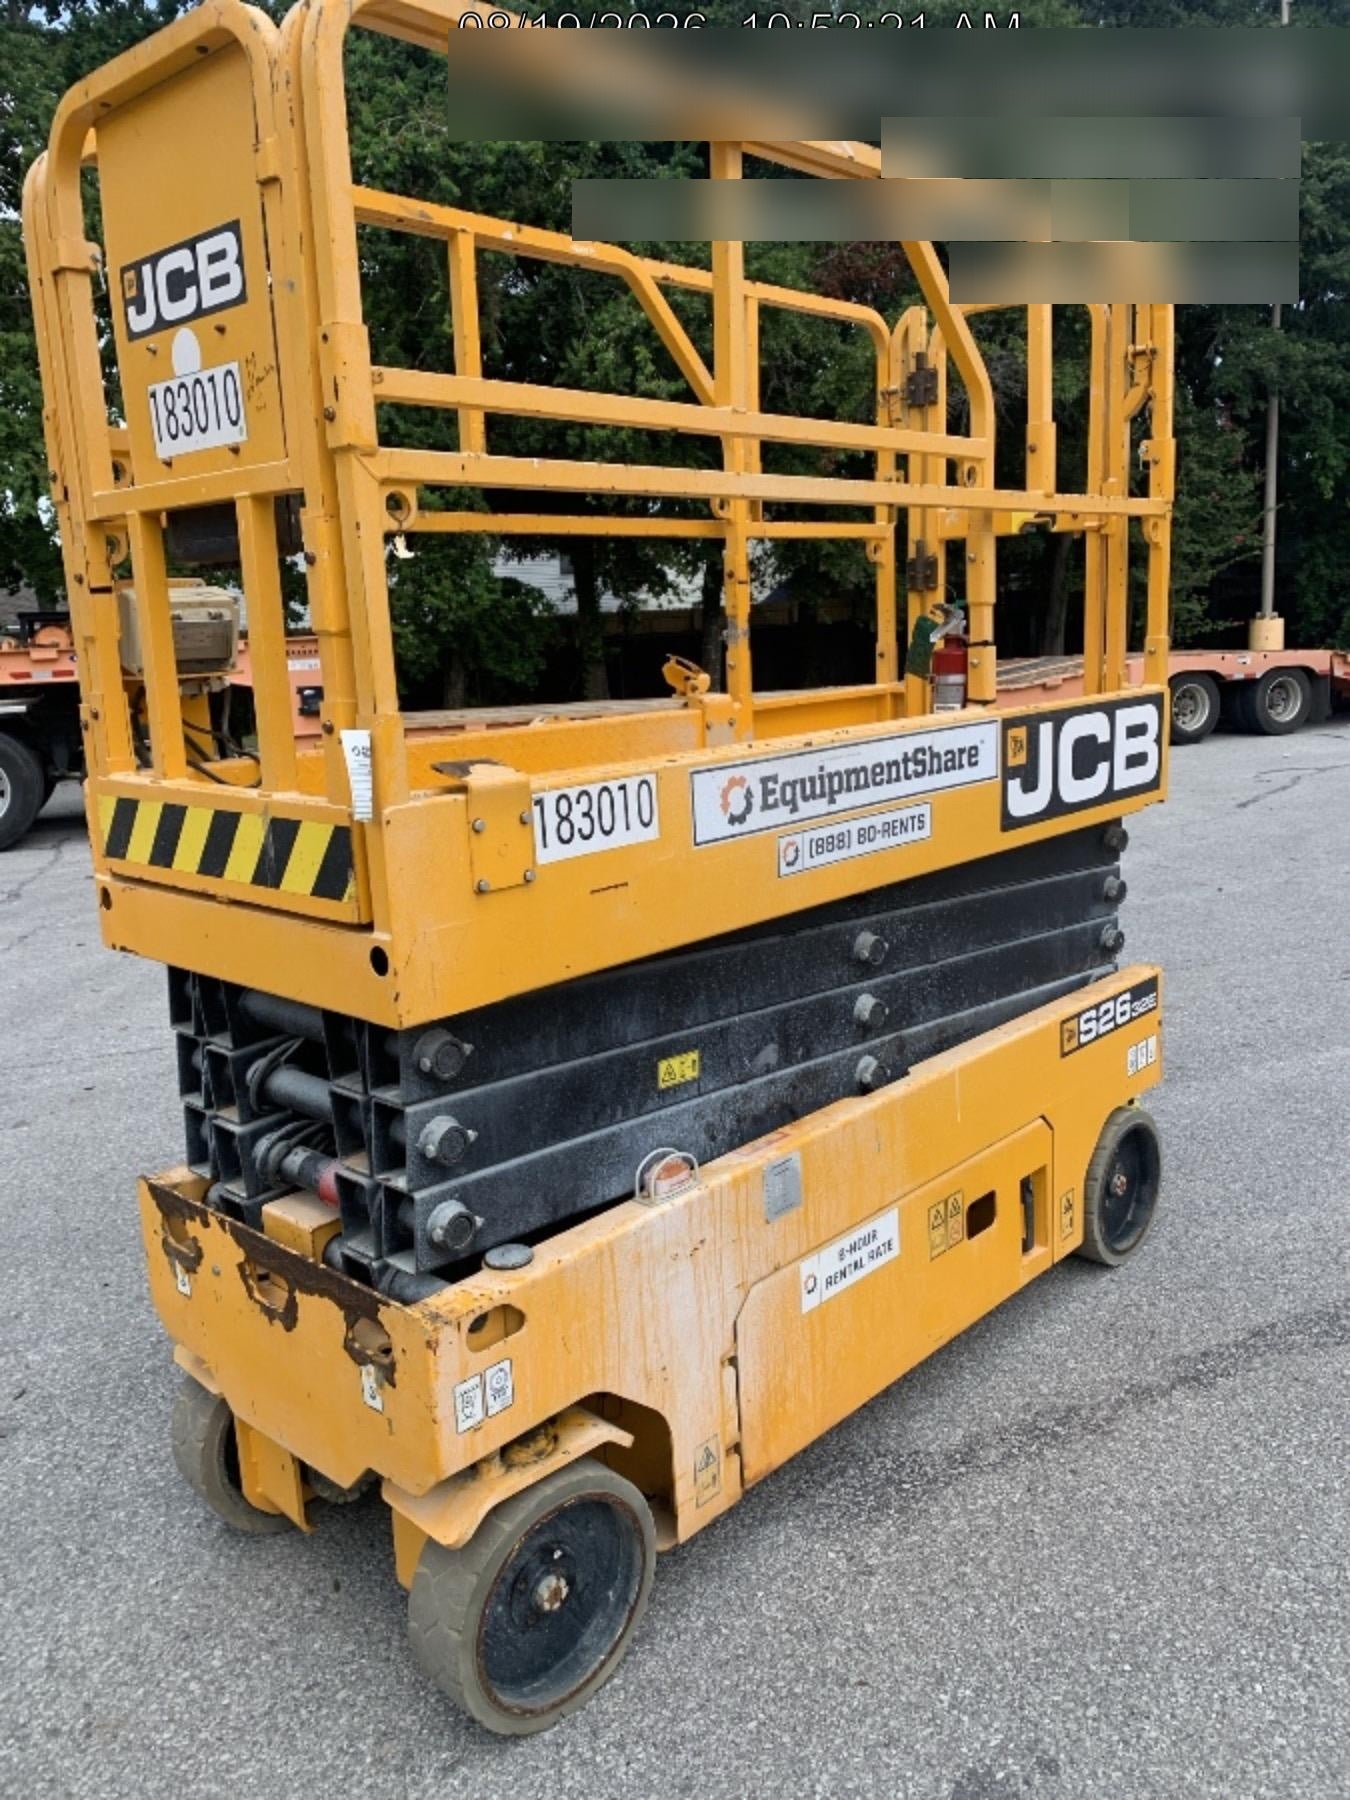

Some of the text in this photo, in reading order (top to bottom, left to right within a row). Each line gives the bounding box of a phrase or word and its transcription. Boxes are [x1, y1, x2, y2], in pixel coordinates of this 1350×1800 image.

[127, 231, 243, 333] JCB
[149, 369, 241, 442] 183010
[760, 745, 979, 814] EquipmentShare
[1007, 703, 1159, 817] JCB
[534, 779, 653, 848] 183010
[825, 1238, 893, 1290] RENTAL RATE
